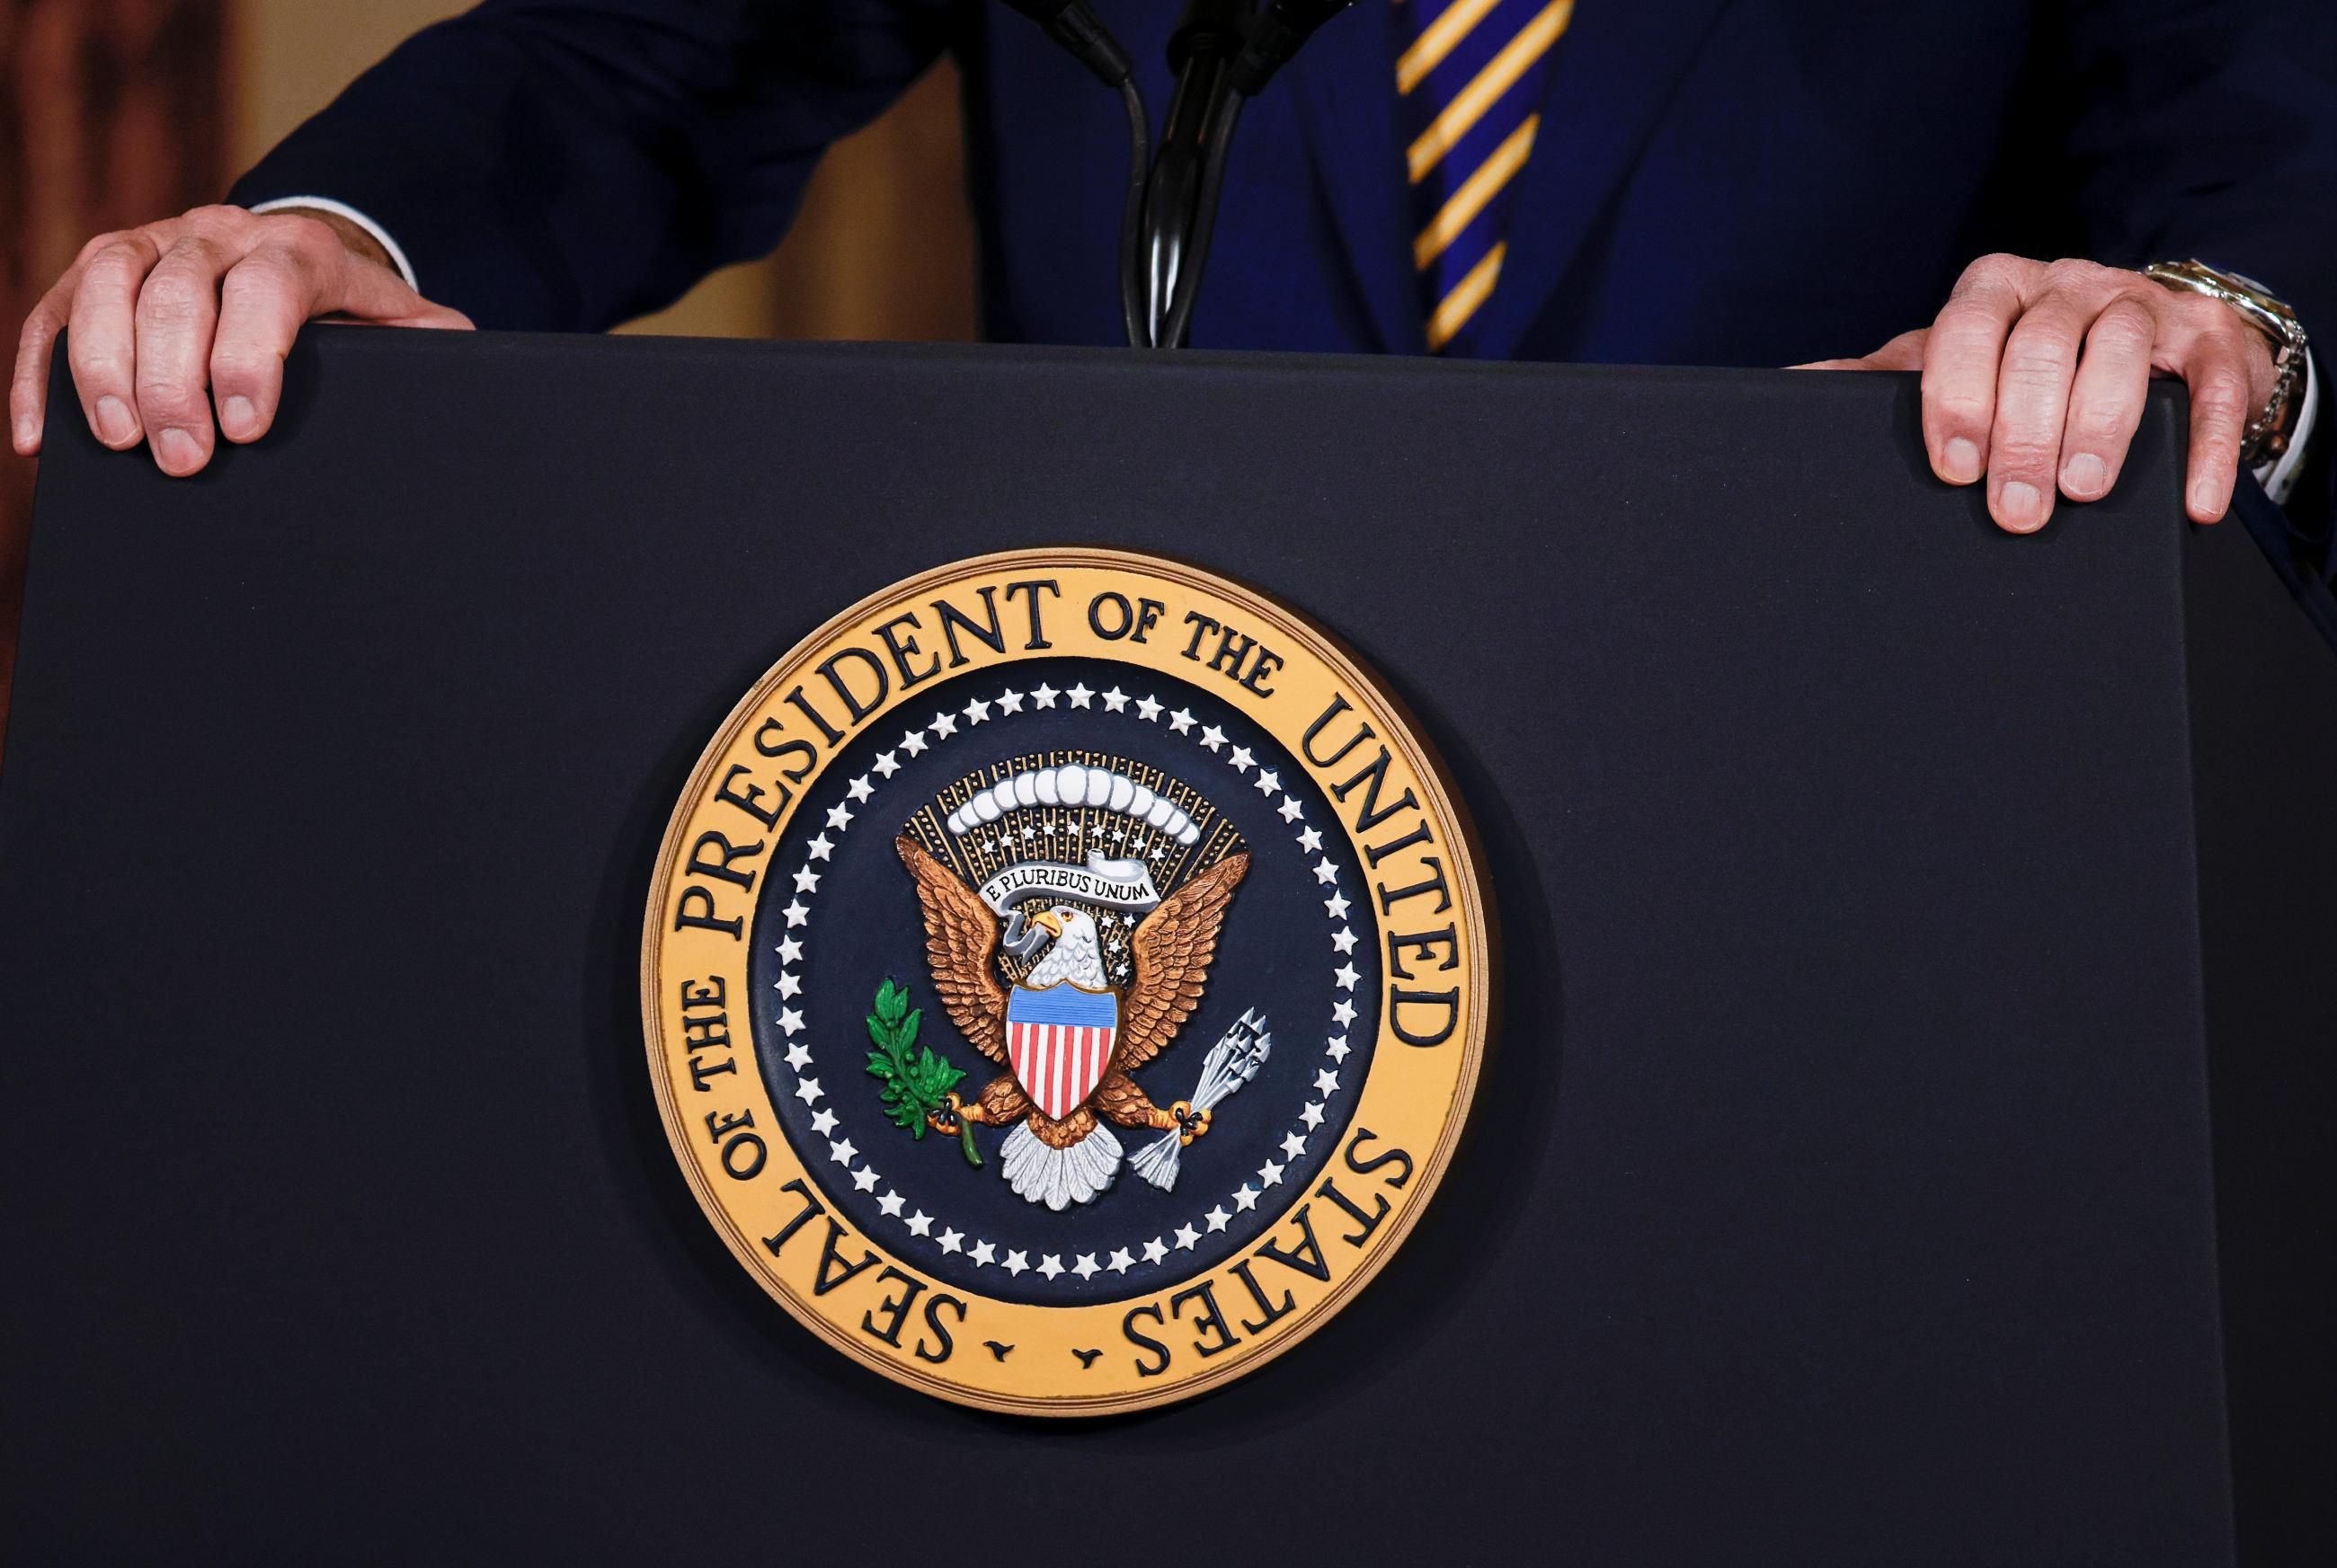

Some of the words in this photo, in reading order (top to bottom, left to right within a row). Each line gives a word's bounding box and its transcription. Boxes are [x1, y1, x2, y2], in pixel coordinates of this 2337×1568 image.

[1088, 590, 1165, 644] OF
[1184, 609, 1284, 697] THE
[676, 579, 1060, 940] PRESIDENT
[986, 885, 1001, 902] E
[999, 868, 1092, 893] PLURIBUS
[1094, 879, 1150, 901] UNUM
[1301, 691, 1460, 1049] UNITED
[681, 974, 737, 1092] THE
[707, 1110, 768, 1179] OF
[762, 1178, 967, 1364] SEAL
[1122, 1127, 1413, 1377] STATES
